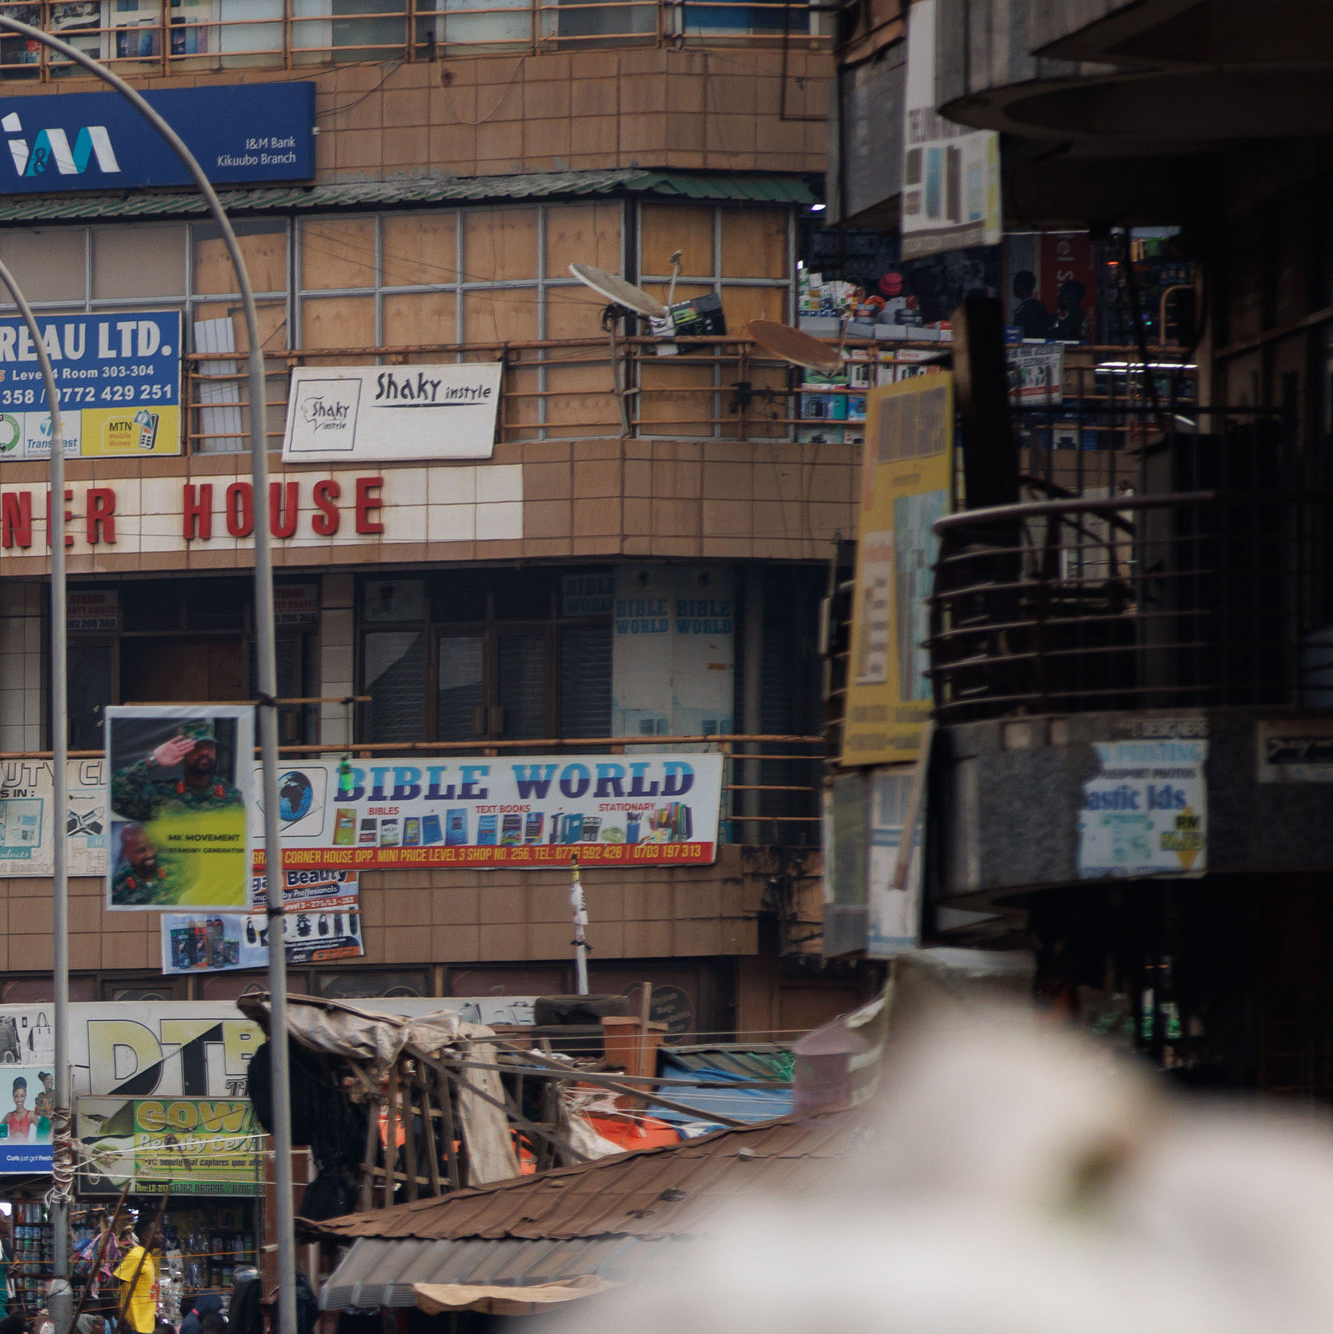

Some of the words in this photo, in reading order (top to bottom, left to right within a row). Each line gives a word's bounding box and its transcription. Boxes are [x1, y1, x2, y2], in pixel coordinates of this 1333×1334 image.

[246, 136, 268, 149] I&M
[271, 136, 296, 149] Bank
[217, 153, 259, 168] Kikuubo
[260, 151, 296, 165] Branch
[98, 320, 172, 359] LTD.
[62, 367, 98, 379] Room
[102, 365, 154, 378] 303-304
[375, 371, 442, 402] Shaky
[2, 389, 35, 405] 358
[101, 385, 134, 400] 429
[140, 384, 172, 400] 251
[109, 422, 133, 431] MTN
[183, 476, 385, 541] HOUSE
[333, 764, 491, 802] BIBLE
[511, 761, 694, 800] WORLD
[368, 806, 400, 815] BIBLES
[475, 805, 498, 814] TEXT
[499, 804, 531, 813] BOOKS
[598, 802, 657, 812] STATIONARY
[167, 834, 183, 842] MK
[185, 834, 241, 842] MOVEMENT
[285, 851, 321, 864] CORNER
[323, 851, 354, 863] HOUSE
[377, 850, 399, 862] MINI
[400, 849, 428, 862] PRICE
[429, 849, 458, 861] LEVEL
[467, 847, 492, 860] SHOP
